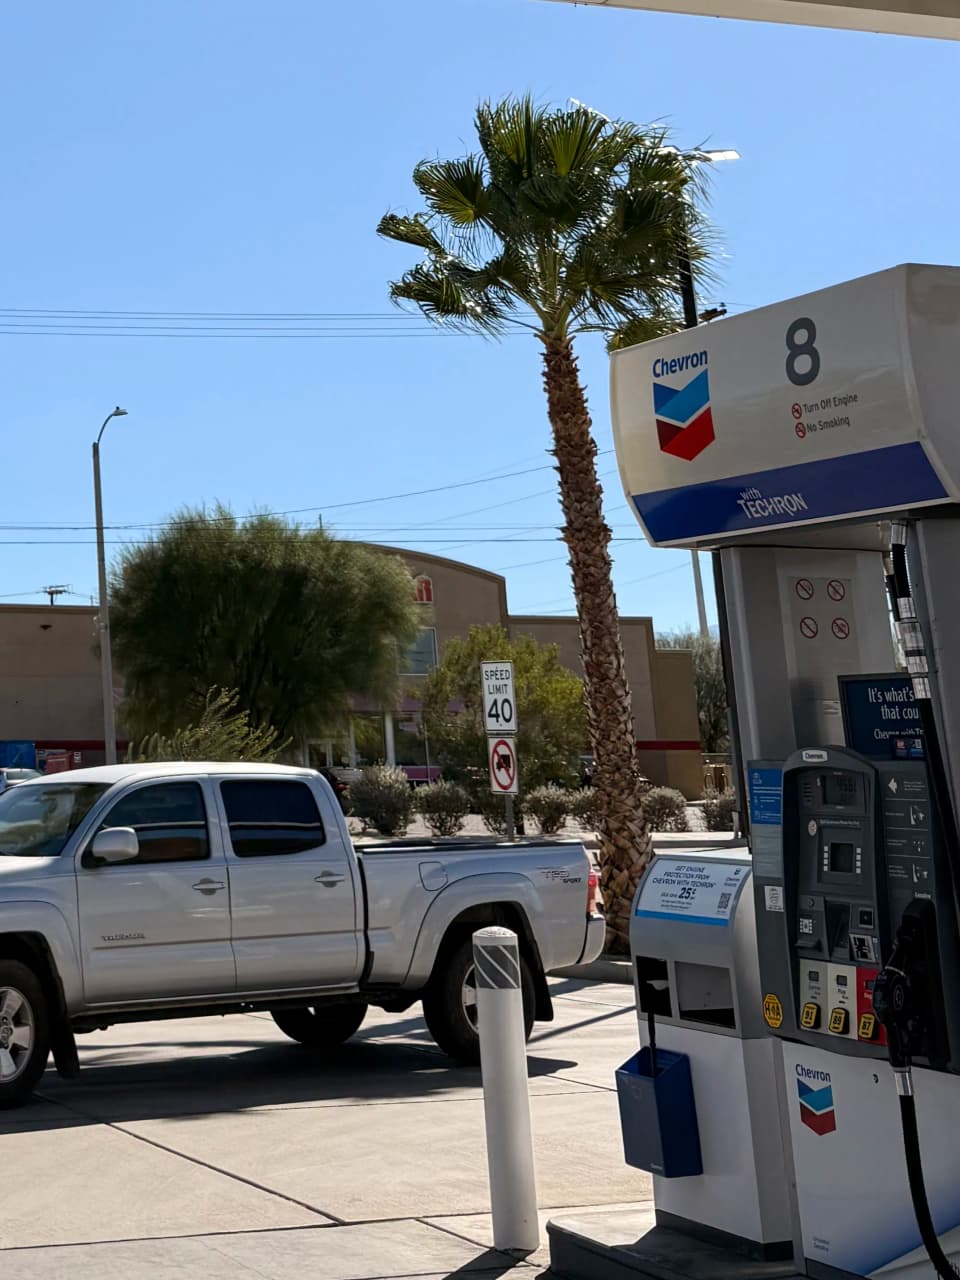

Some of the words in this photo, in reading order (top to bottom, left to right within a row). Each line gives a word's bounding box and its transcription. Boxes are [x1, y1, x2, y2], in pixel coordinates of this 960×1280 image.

[786, 317, 821, 386] 8
[653, 350, 708, 378] Chevron
[803, 403, 820, 413] Turn
[820, 397, 832, 410] Off
[832, 394, 858, 407] Engine
[806, 423, 817, 432] No
[818, 416, 850, 431] Smoking
[740, 487, 762, 500] with
[737, 493, 808, 519] TECHRON
[484, 669, 511, 681] SPEED
[487, 683, 508, 695] LIMIT
[867, 687, 883, 703] It's
[884, 686, 915, 702] what's
[487, 698, 513, 723] 40
[880, 704, 901, 720] that
[902, 707, 920, 719] cou
[652, 877, 676, 885] CHEVRON
[676, 879, 690, 887] WITH
[795, 1063, 831, 1082] Chevron
